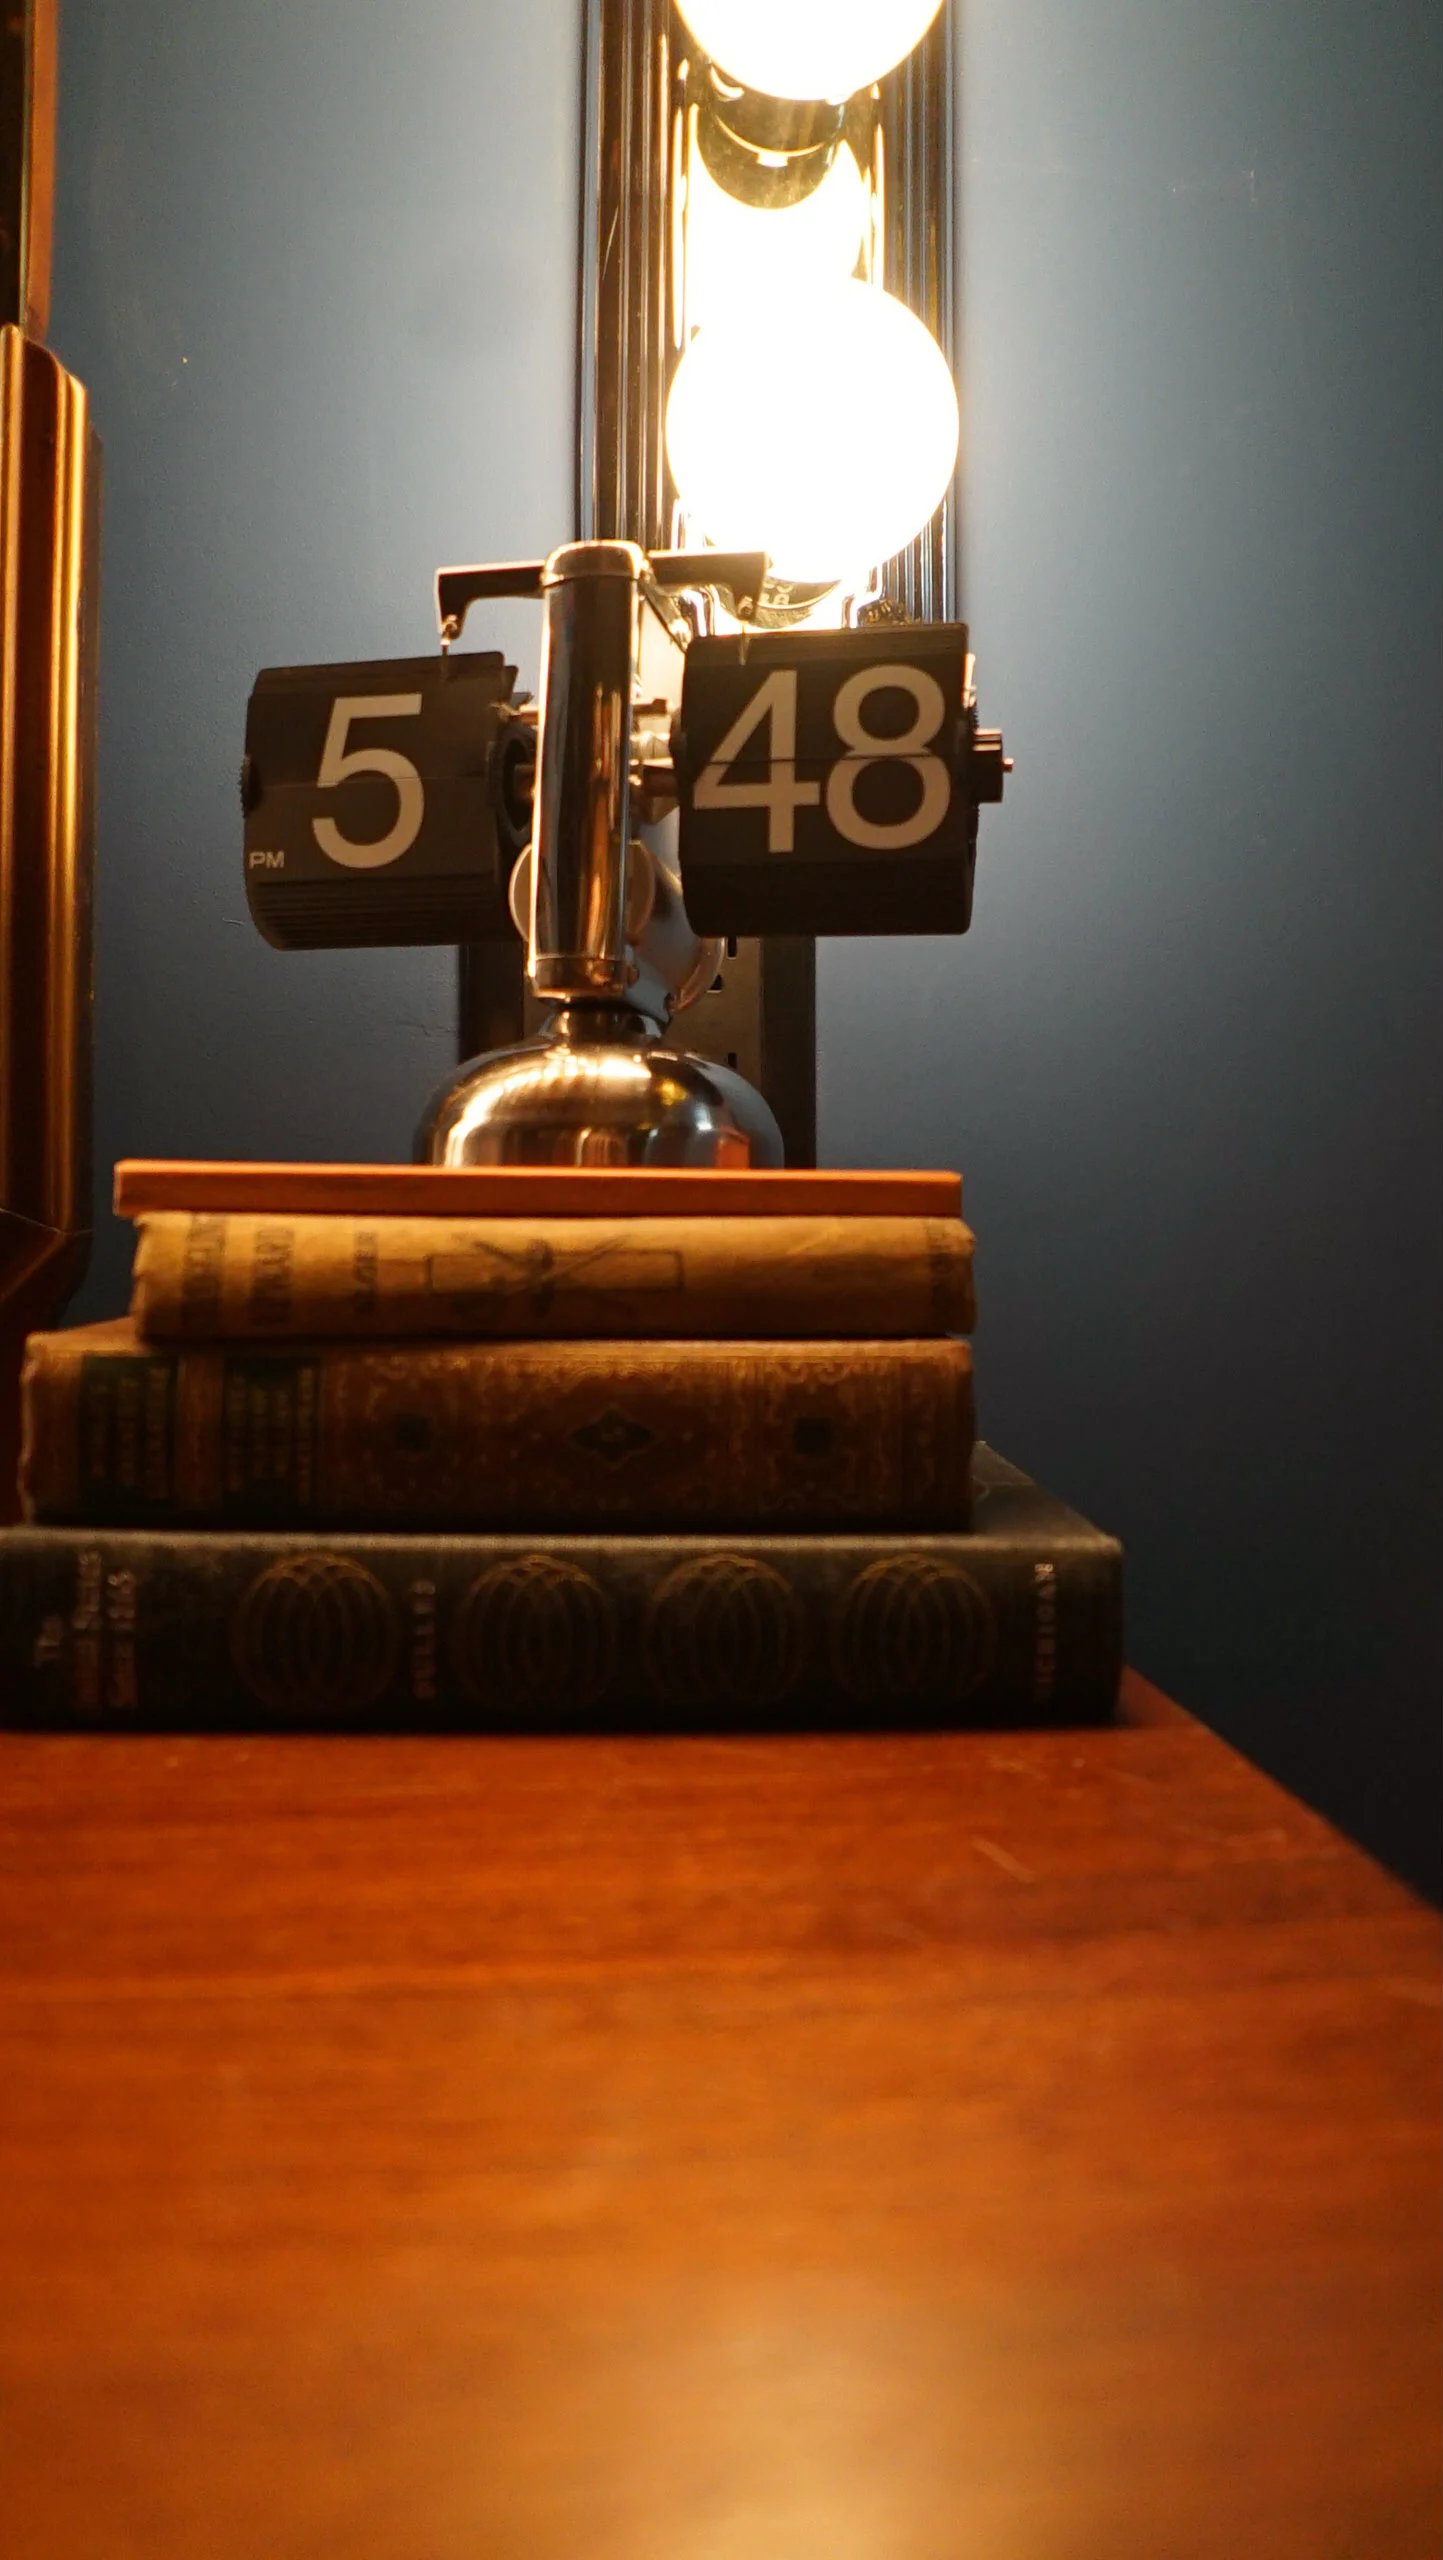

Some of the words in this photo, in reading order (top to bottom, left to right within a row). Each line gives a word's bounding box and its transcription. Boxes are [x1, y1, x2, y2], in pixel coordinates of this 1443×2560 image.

[312, 693, 425, 869] 5
[693, 664, 950, 853] 48
[250, 851, 285, 869] PM
